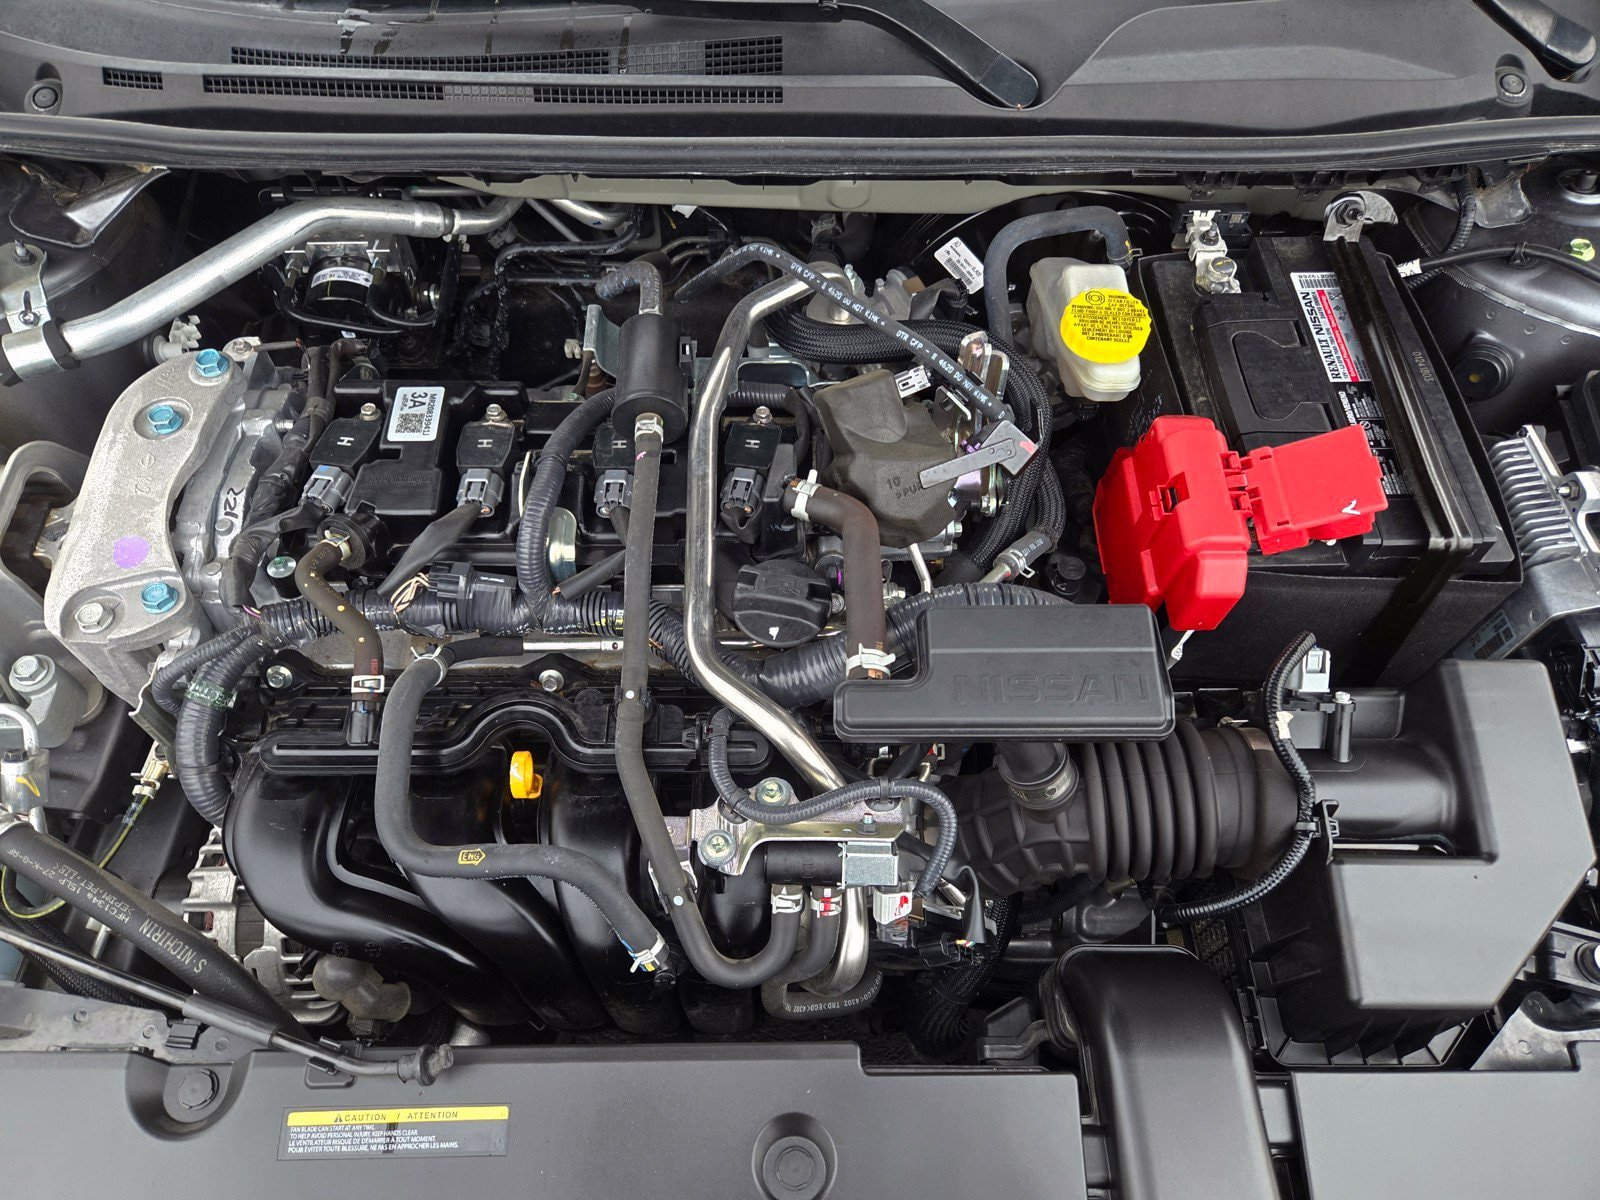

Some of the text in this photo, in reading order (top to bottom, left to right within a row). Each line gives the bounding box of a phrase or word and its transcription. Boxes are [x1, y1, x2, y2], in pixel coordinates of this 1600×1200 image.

[760, 246, 774, 256] KINK
[790, 262, 803, 274] DTR
[828, 287, 842, 300] 4620
[852, 303, 864, 313] NOT
[865, 309, 880, 323] KINK
[1300, 292, 1326, 336] NISSAN
[896, 330, 909, 342] DTR
[939, 359, 955, 374] 4620
[962, 380, 974, 391] NOT
[973, 390, 989, 404] KINK
[1319, 338, 1342, 380] RENAULT
[408, 392, 428, 409] 3A
[954, 674, 1150, 705] NISSAN
[345, 1113, 386, 1121] CAUTION
[407, 1111, 458, 1119] ATTENTION
